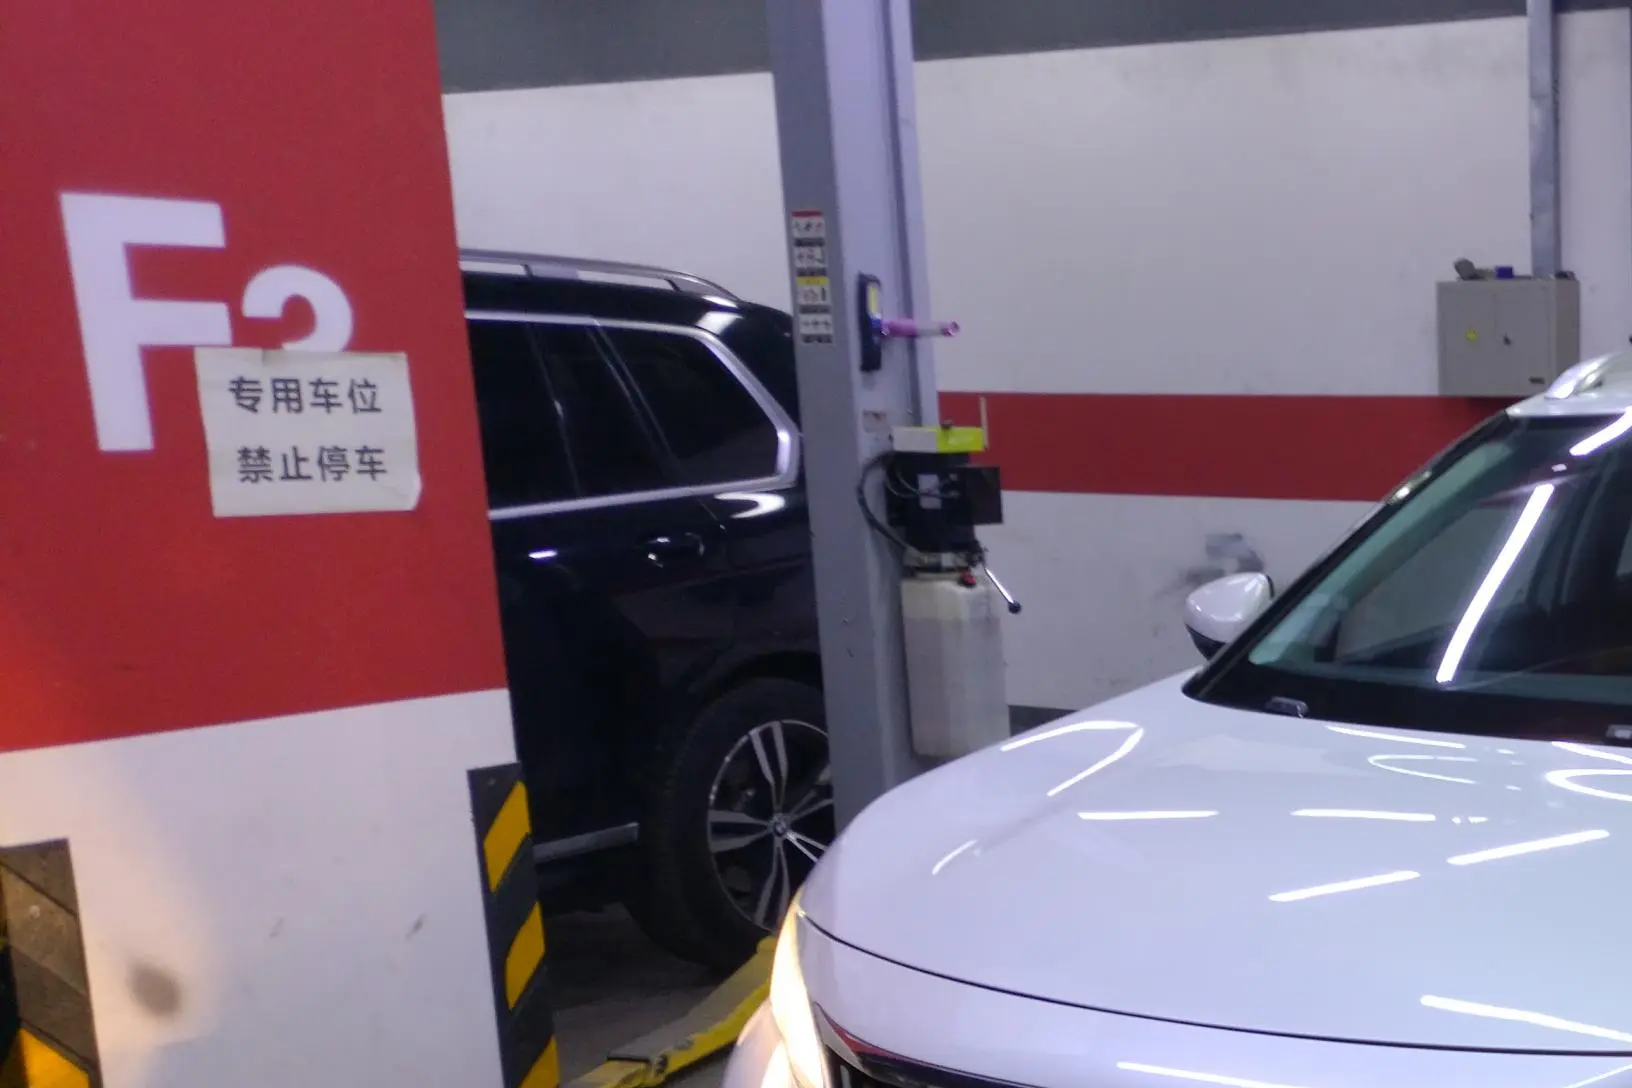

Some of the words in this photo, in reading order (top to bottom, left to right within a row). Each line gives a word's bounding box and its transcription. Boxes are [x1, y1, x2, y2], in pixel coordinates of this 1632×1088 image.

[228, 376, 382, 416] 专用车位
[237, 445, 388, 484] 禁止停车
